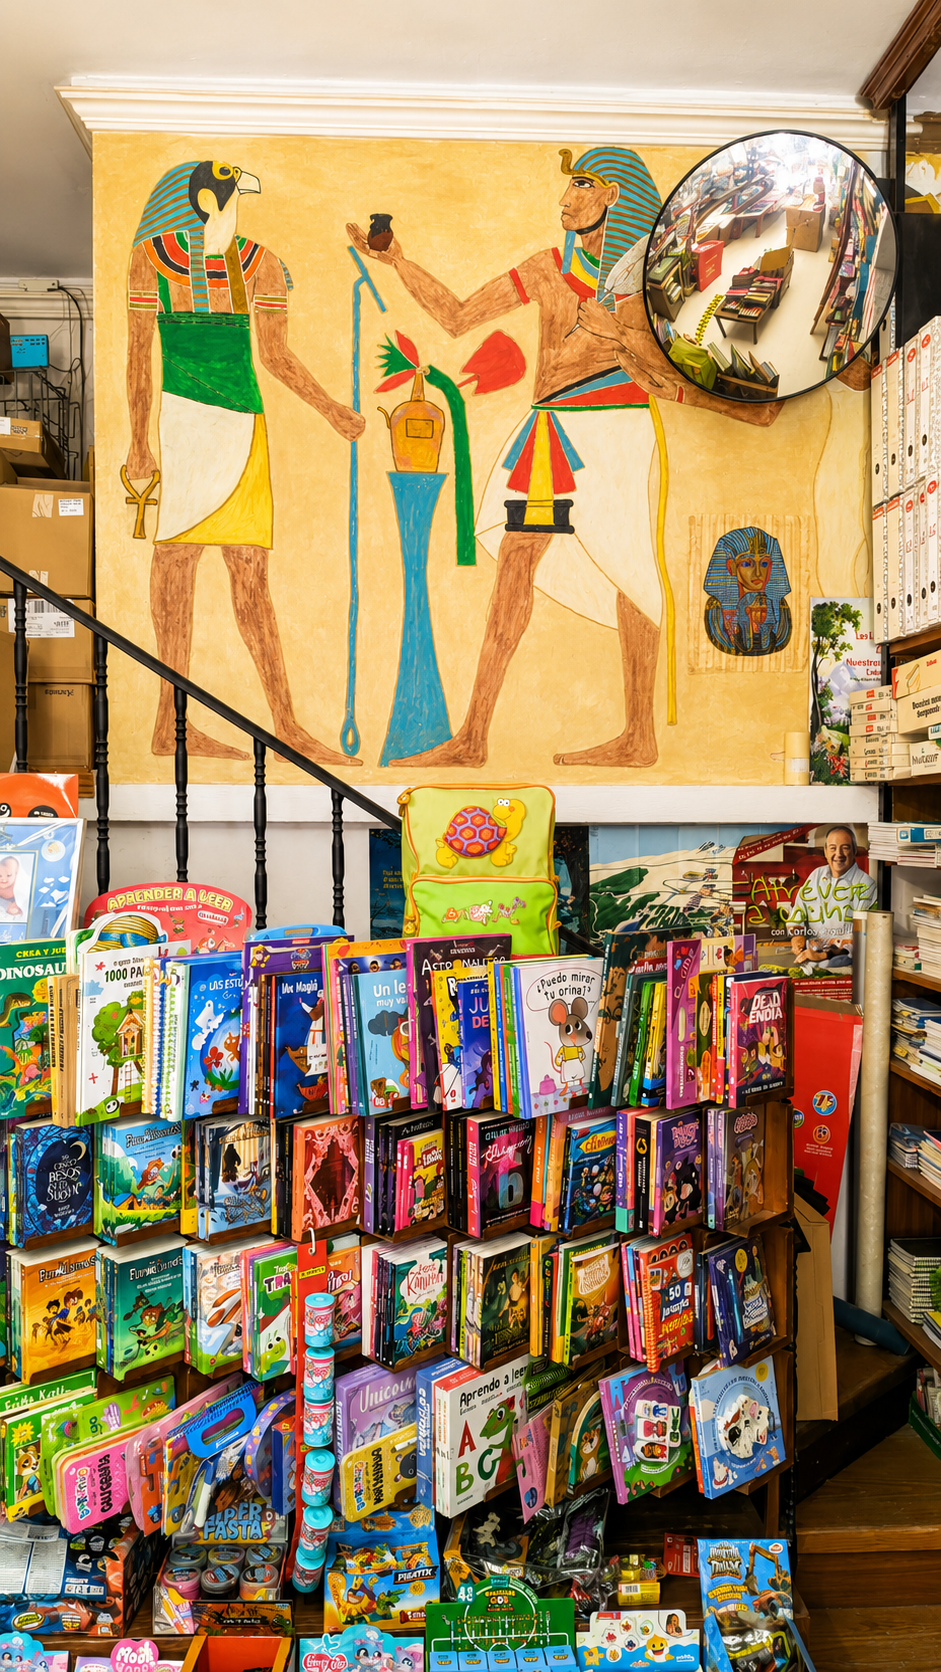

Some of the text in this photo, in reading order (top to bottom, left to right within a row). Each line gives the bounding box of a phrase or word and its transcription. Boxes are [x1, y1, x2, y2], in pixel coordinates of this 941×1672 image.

[107, 886, 234, 913] APRENDER A LEER
[771, 928, 785, 936] con
[43, 948, 49, 956] Y
[105, 966, 144, 982] 1000 PA
[571, 972, 596, 985] mirar
[373, 984, 391, 997] Un
[752, 991, 781, 1010] DEAD
[669, 1284, 681, 1301] 50
[459, 1377, 500, 1408] Aprendo
[504, 1374, 509, 1386] a
[458, 1420, 477, 1459] A
[456, 1462, 474, 1496] B
